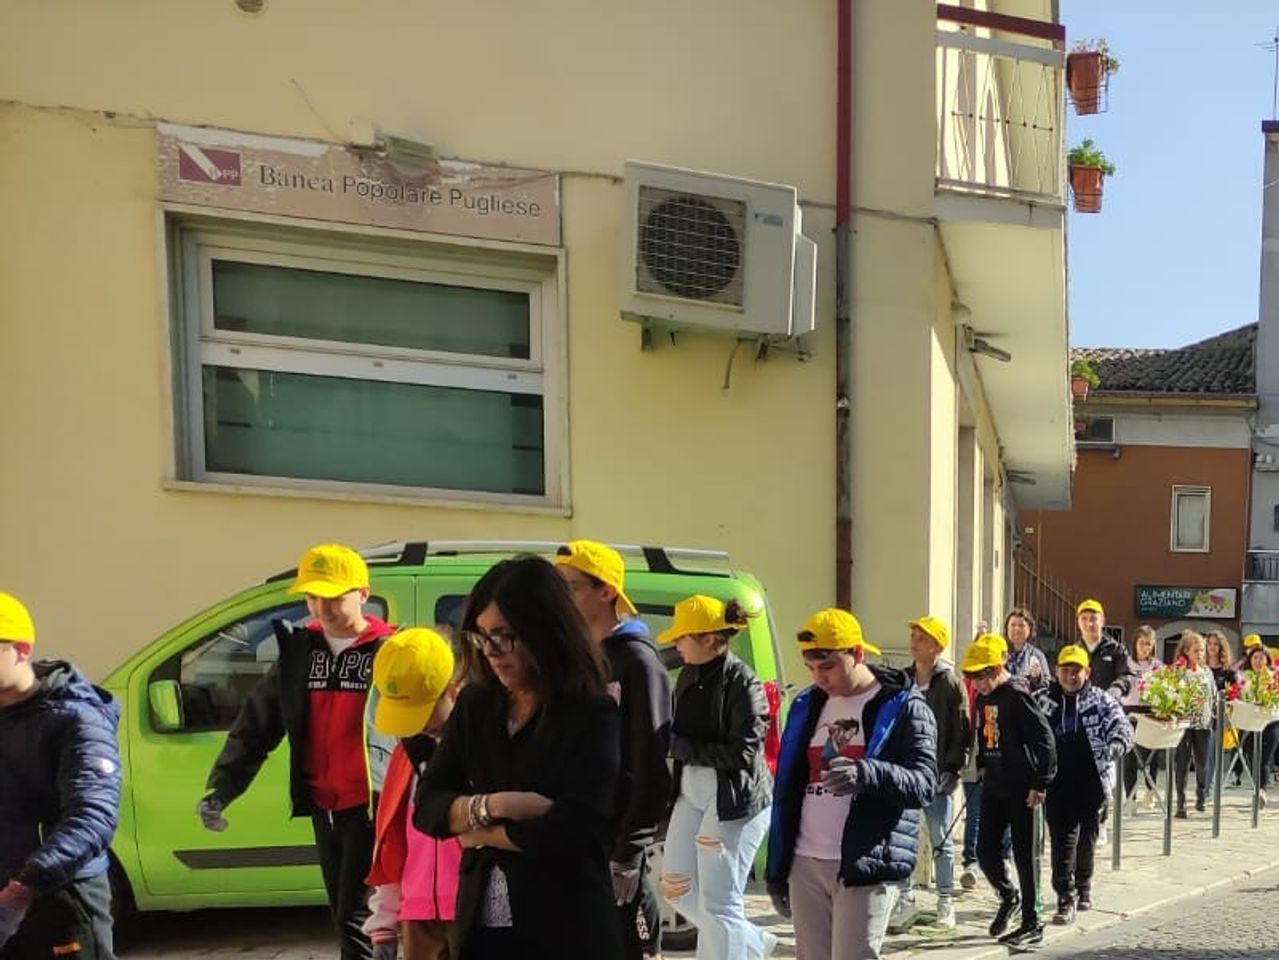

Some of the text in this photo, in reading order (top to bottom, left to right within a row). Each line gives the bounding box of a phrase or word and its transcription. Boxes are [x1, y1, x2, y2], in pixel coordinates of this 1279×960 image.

[258, 164, 541, 216] Banca Popolare Pugliese
